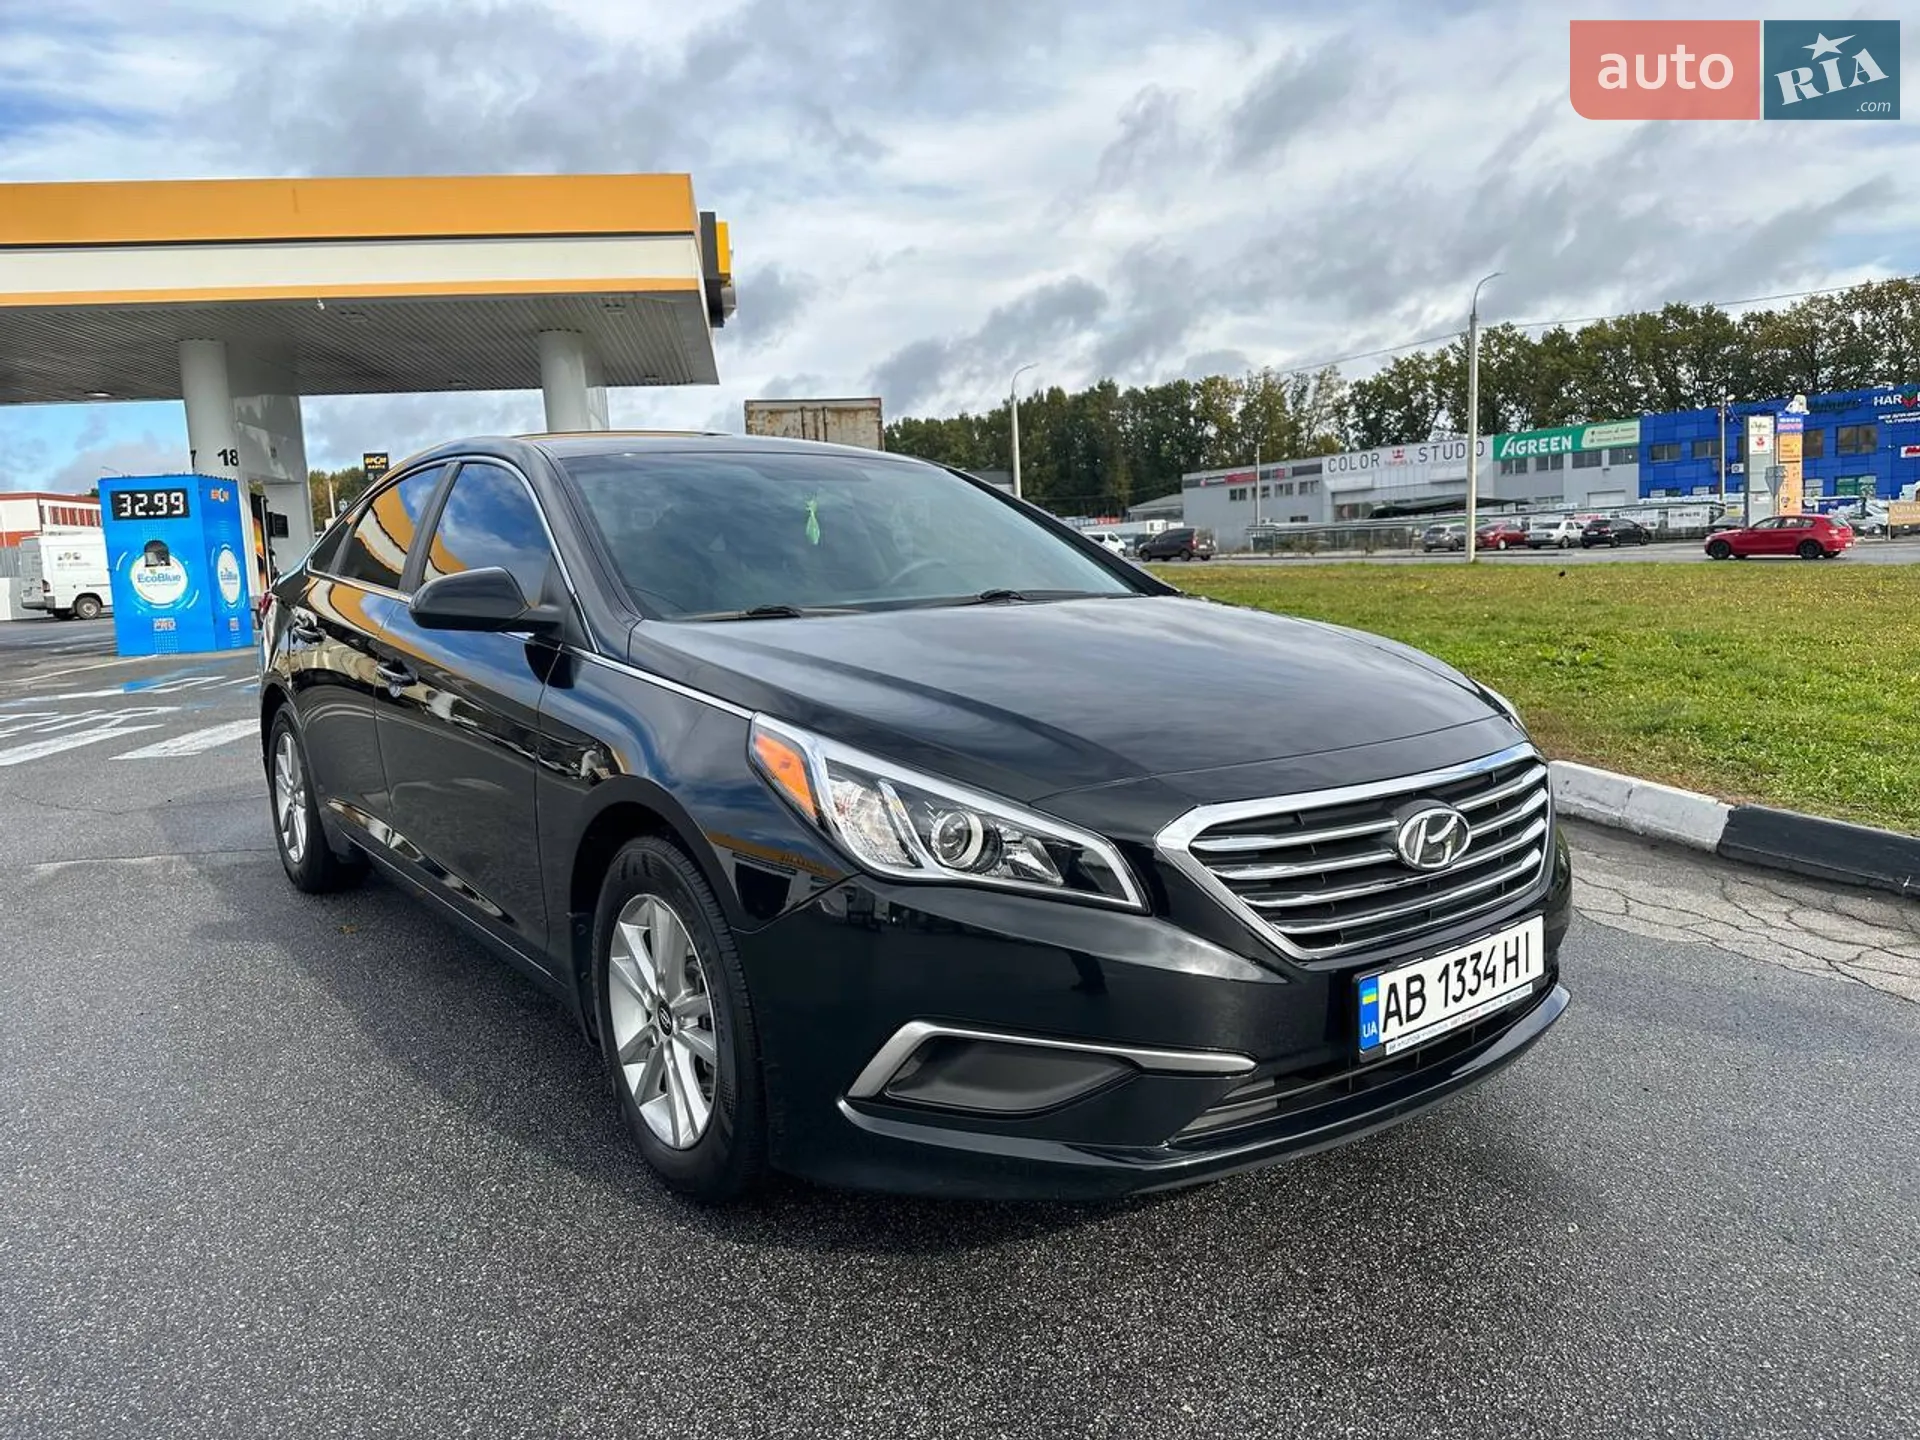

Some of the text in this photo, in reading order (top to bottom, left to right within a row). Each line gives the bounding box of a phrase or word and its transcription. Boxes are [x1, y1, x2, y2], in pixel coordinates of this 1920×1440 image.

[217, 448, 240, 467] 18
[1327, 452, 1380, 473] COLOR
[1418, 440, 1485, 463] STUDO
[1500, 435, 1572, 458] AGREEN
[118, 491, 184, 517] 32.99
[137, 572, 182, 584] EcoBlue
[1382, 974, 1427, 1033] AB
[1437, 945, 1497, 1009] 1334
[1503, 931, 1530, 984] HI
[1362, 1022, 1379, 1038] UA
